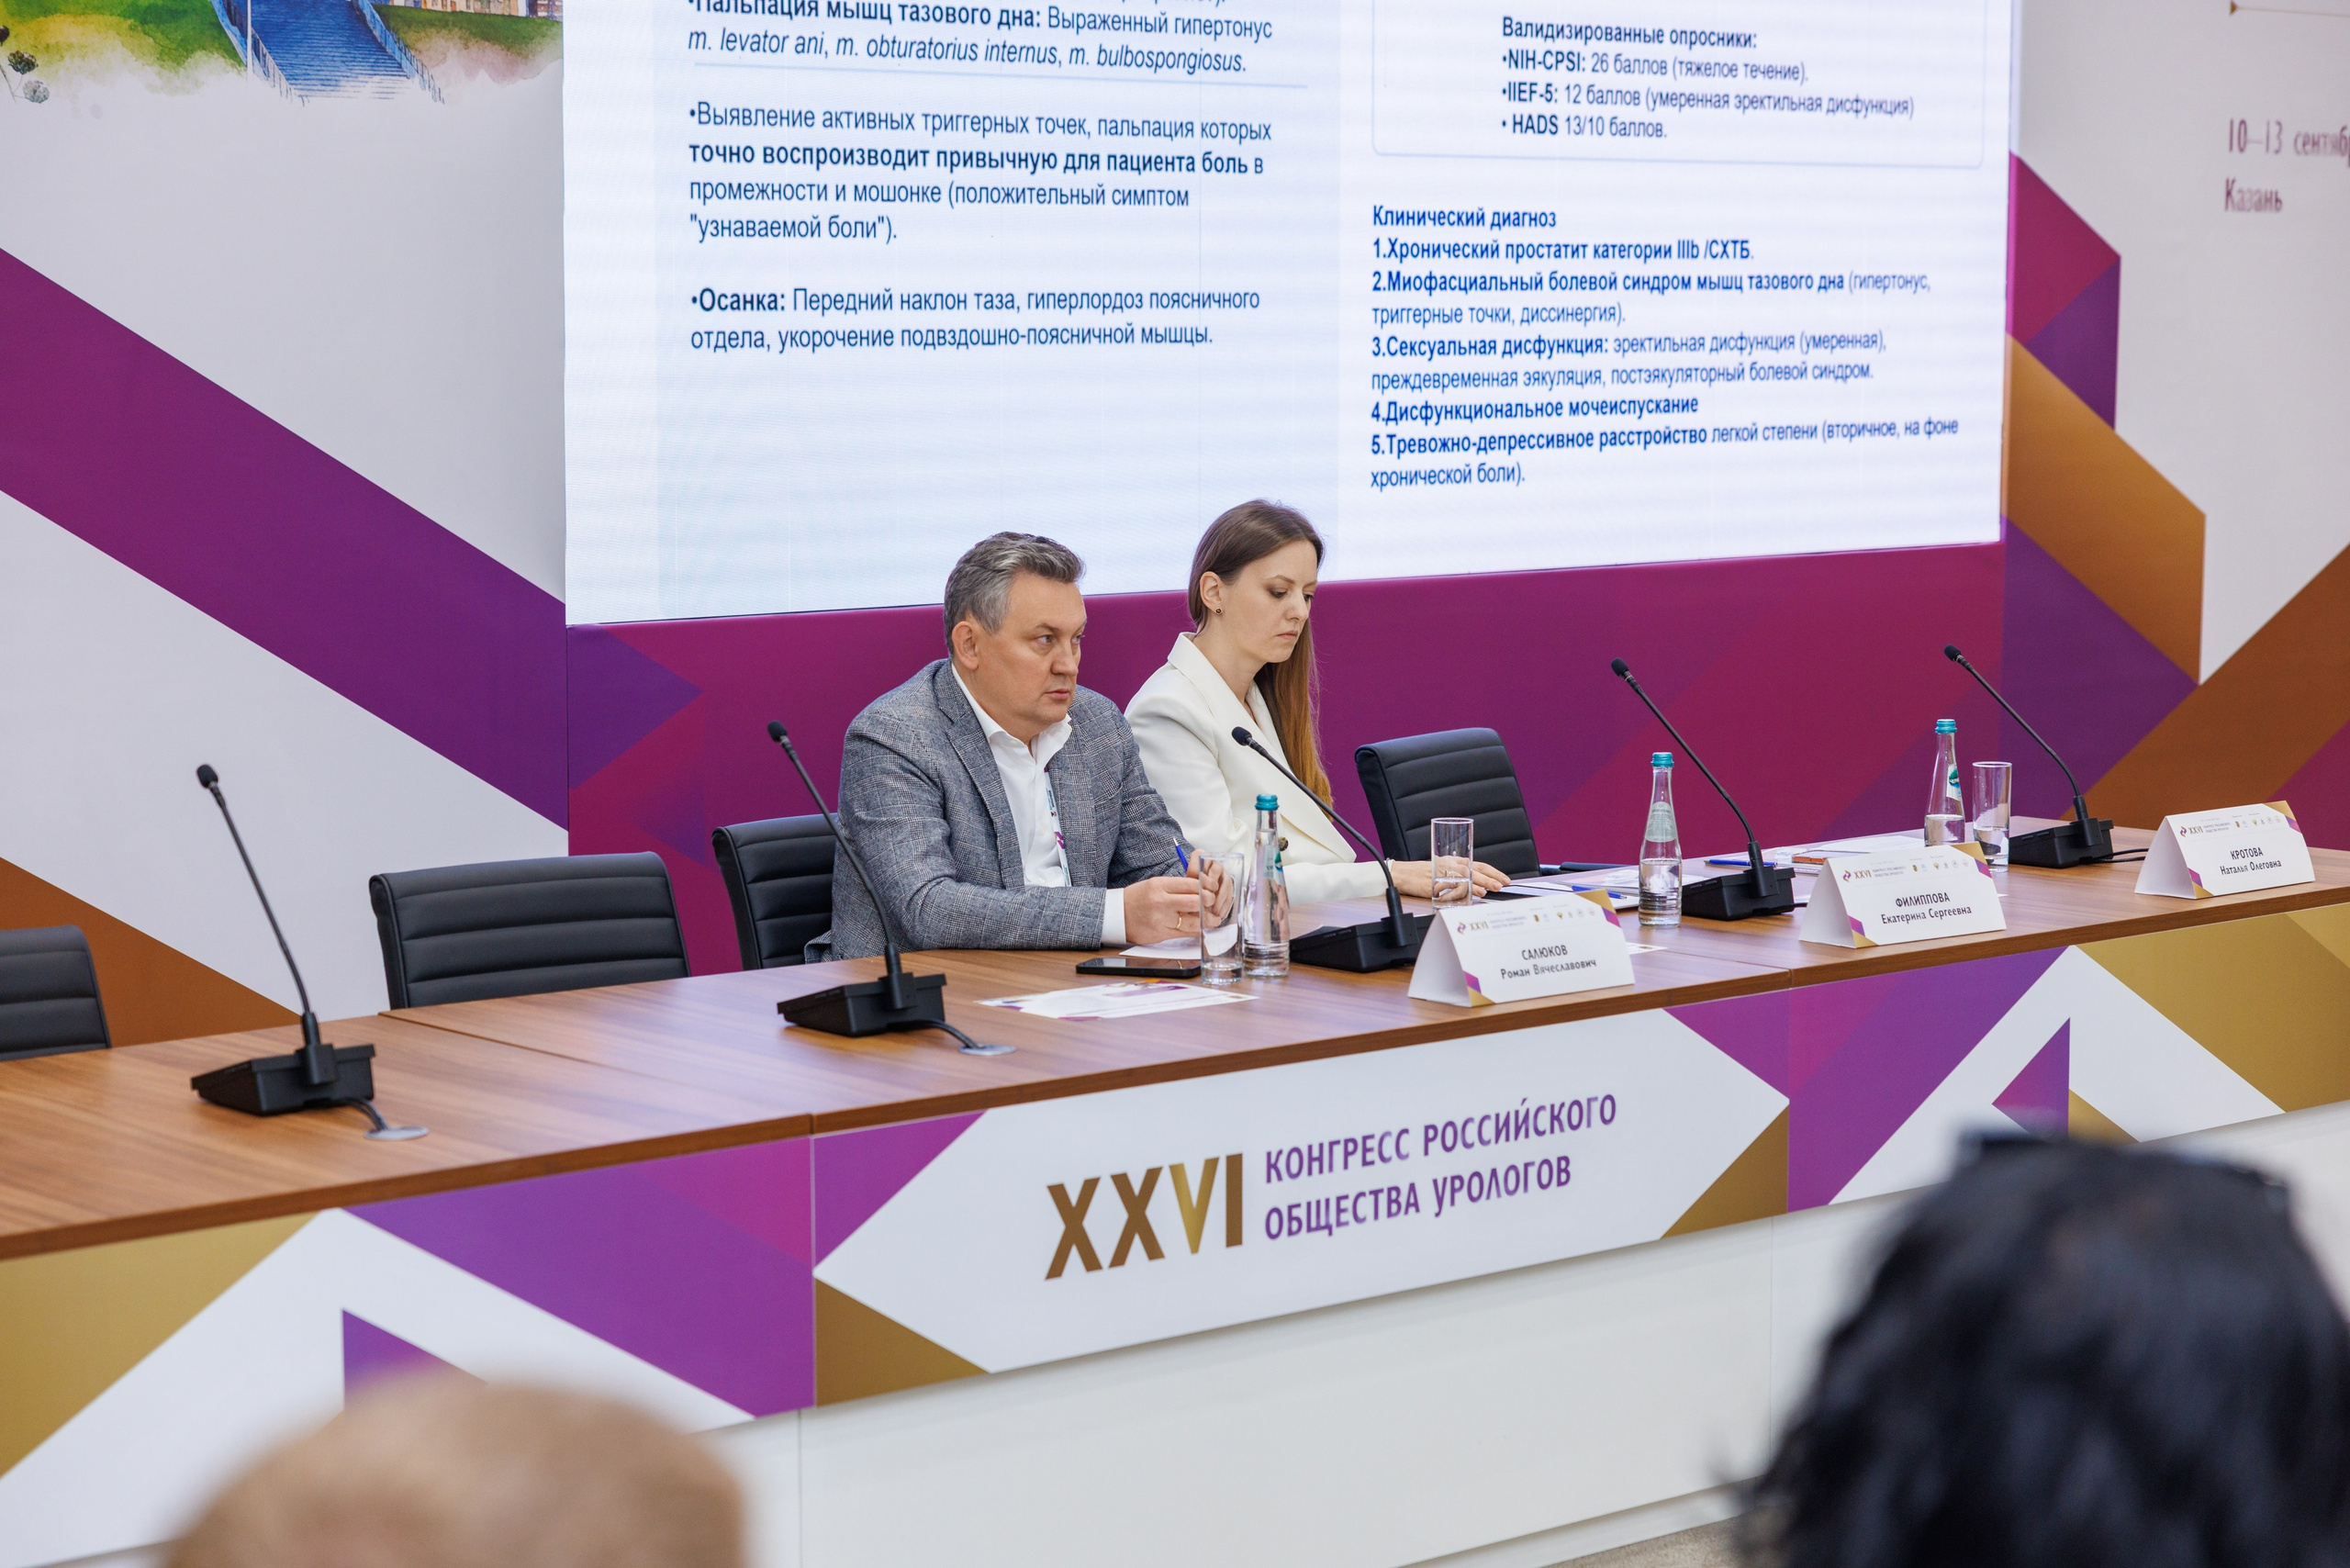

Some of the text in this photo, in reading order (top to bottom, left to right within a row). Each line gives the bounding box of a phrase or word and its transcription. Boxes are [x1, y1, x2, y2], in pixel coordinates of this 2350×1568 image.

[827, 1, 892, 25] мышц
[898, 4, 990, 25] тазового
[997, 9, 1040, 30] дна:
[1048, 6, 1168, 35] Выраженный
[1175, 17, 1272, 43] гипертонус
[1503, 17, 1756, 50] Валидизированные опросники:
[688, 28, 1246, 75] m. levator ani, m. obturatorius internus, m. bulbospongiosus.
[1591, 52, 1609, 73] 26
[1614, 53, 1667, 75] баллов
[1673, 57, 1738, 80] (тяжелое
[1743, 62, 1807, 85] течение).
[1565, 84, 1582, 104] 12
[1586, 84, 1640, 106] баллов
[1646, 87, 1729, 112] (умеренная
[1734, 94, 1822, 114] эректильная
[1826, 95, 1914, 118] дисфункция)
[822, 111, 914, 130] активных
[922, 114, 1029, 139] триггерных
[1035, 117, 1091, 139] точек,
[1098, 118, 1193, 141] пальпация
[1201, 122, 1271, 145] которых
[1513, 114, 1666, 138] HADS 13/10 баллов.
[689, 145, 1263, 175] точно воспроизводит привычную для пациента боль в
[690, 181, 1189, 208] промежности и мошонке (положительный симптом
[690, 214, 896, 244] "узнаваемой боли").
[1373, 206, 1556, 230] Клинический диагноз
[1373, 238, 1754, 263] 1.Хронический простатит категории IIIb /СХТБ.
[1372, 271, 1930, 297] 2.Миофасциальный болевой синдром мышц тазового дна (гипертонус,
[794, 288, 892, 317] Передний
[901, 293, 967, 310] наклон
[974, 293, 1020, 313] таза,
[1028, 293, 1143, 315] гиперлордоз
[1150, 292, 1259, 308] поясничного
[1372, 302, 1625, 329] триггерные точки, диссинергия).
[691, 323, 1212, 354] отдела, укорочение подвздошно-поясничной мышцы.
[1372, 330, 1886, 362] 3.Сексуальная дисфункция: эректильная дисфункция (умеренная),
[1372, 362, 1874, 395] преждевременная эякуляция, постэякуляторный болевой синдром.
[1371, 398, 1698, 426] 4.Дисфункциональное мочеиспускание
[1371, 417, 1958, 459] 5.Тревожно-депрессивное расстройство легкой степени (вторичное, на фоне
[1371, 462, 1525, 492] хронической боли).
[2220, 860, 2281, 875] Наталья Олеговна
[2231, 847, 2264, 859] КРОТОВА
[1896, 892, 1950, 907] ФИЛИППОВА
[1881, 907, 1972, 924] Екатерина Сергеевна
[1522, 945, 1568, 960] САЛЮКОВ
[1501, 960, 1596, 979] Роман Вячеславович
[1267, 1094, 1616, 1183] КОНГРЕСС РОССИЙСКОГО
[1265, 1156, 1571, 1240] ОБЩЕСТВА УРОЛОГОВ
[1045, 1153, 1243, 1281] XXVI
